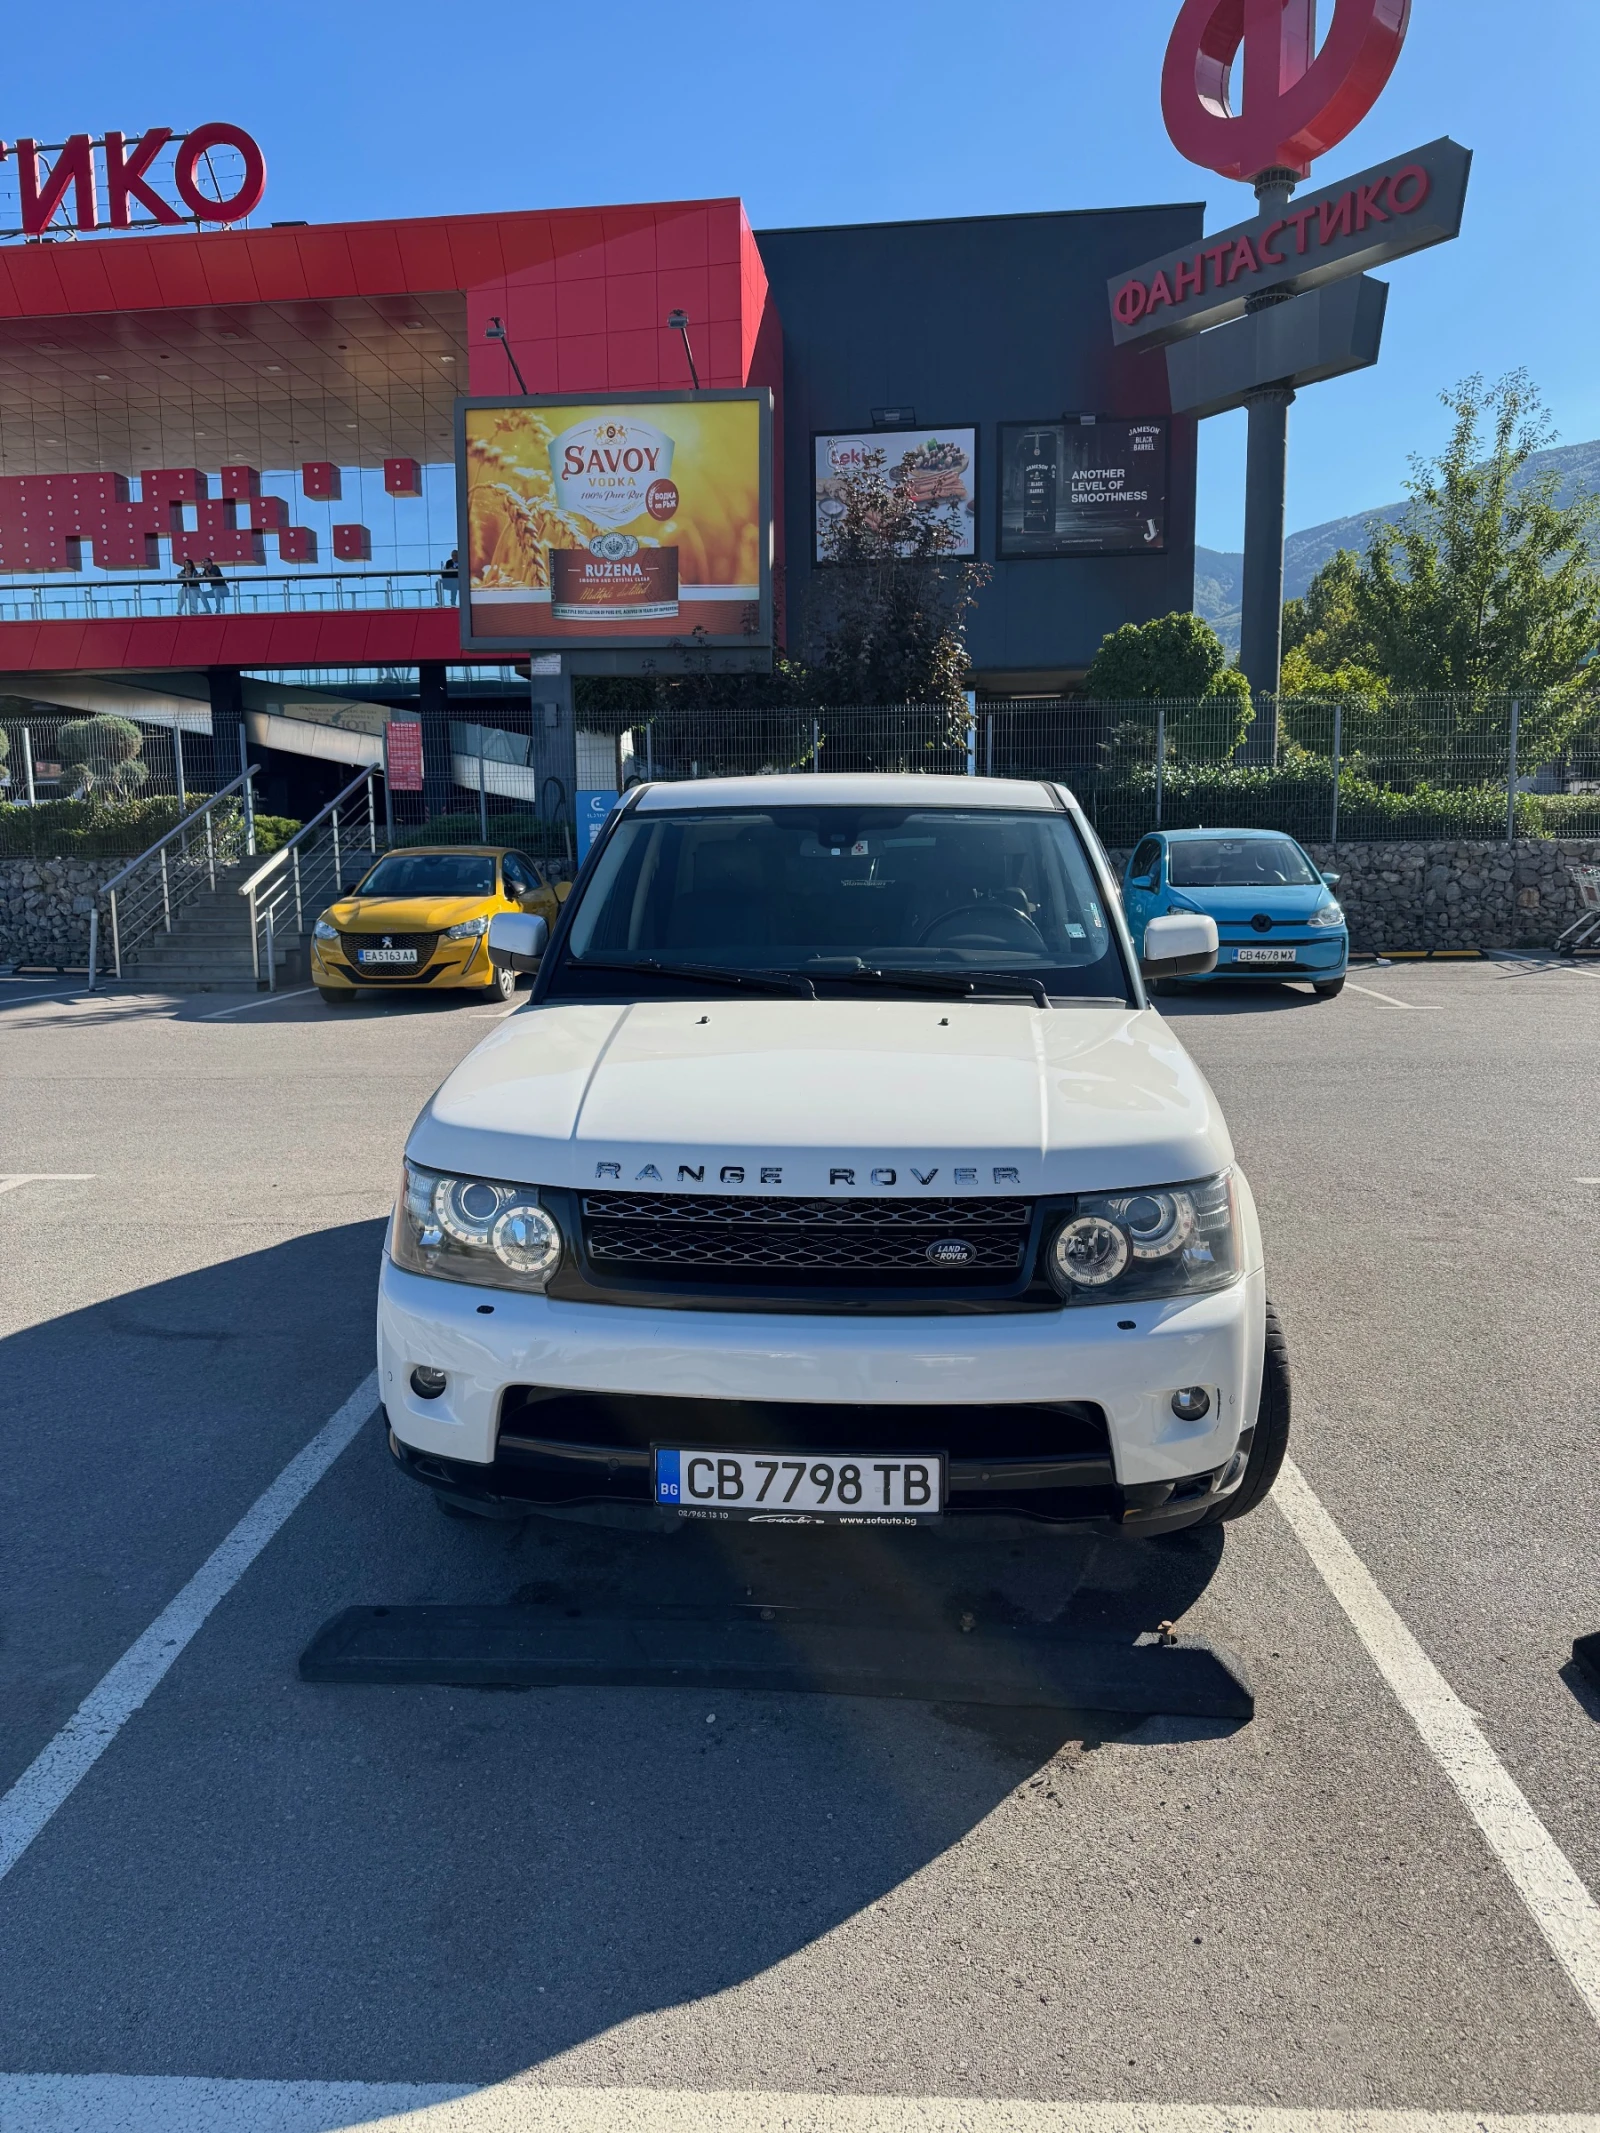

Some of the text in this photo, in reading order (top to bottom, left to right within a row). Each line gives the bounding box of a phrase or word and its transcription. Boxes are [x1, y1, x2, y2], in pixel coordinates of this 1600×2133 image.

[0, 122, 267, 236] ИКО
[1112, 164, 1432, 326] ФАНТАСТИКО
[1128, 425, 1161, 436] JAMESON
[1133, 443, 1155, 451] BARREL
[561, 445, 660, 481] SAVOY
[1071, 468, 1125, 480] ANOTHER
[588, 477, 636, 487] VODKA
[1071, 480, 1124, 492] LEVEL OF
[603, 490, 626, 501] Pure
[626, 489, 645, 501] Rye
[654, 491, 677, 500] ВОДКА
[1071, 491, 1148, 504] SMOOTHNESS
[585, 561, 643, 577] RUŽENA
[365, 951, 416, 961] EA 5163 AA
[1239, 950, 1294, 960] CB 4678 MX
[594, 1161, 1022, 1187] RANGE ROVER
[686, 1457, 932, 1507] CB 7798 TB
[660, 1481, 679, 1496] BG
[677, 1509, 707, 1518] 02/962
[719, 1511, 729, 1519] 10
[839, 1514, 917, 1526] www.sofauto.bg
